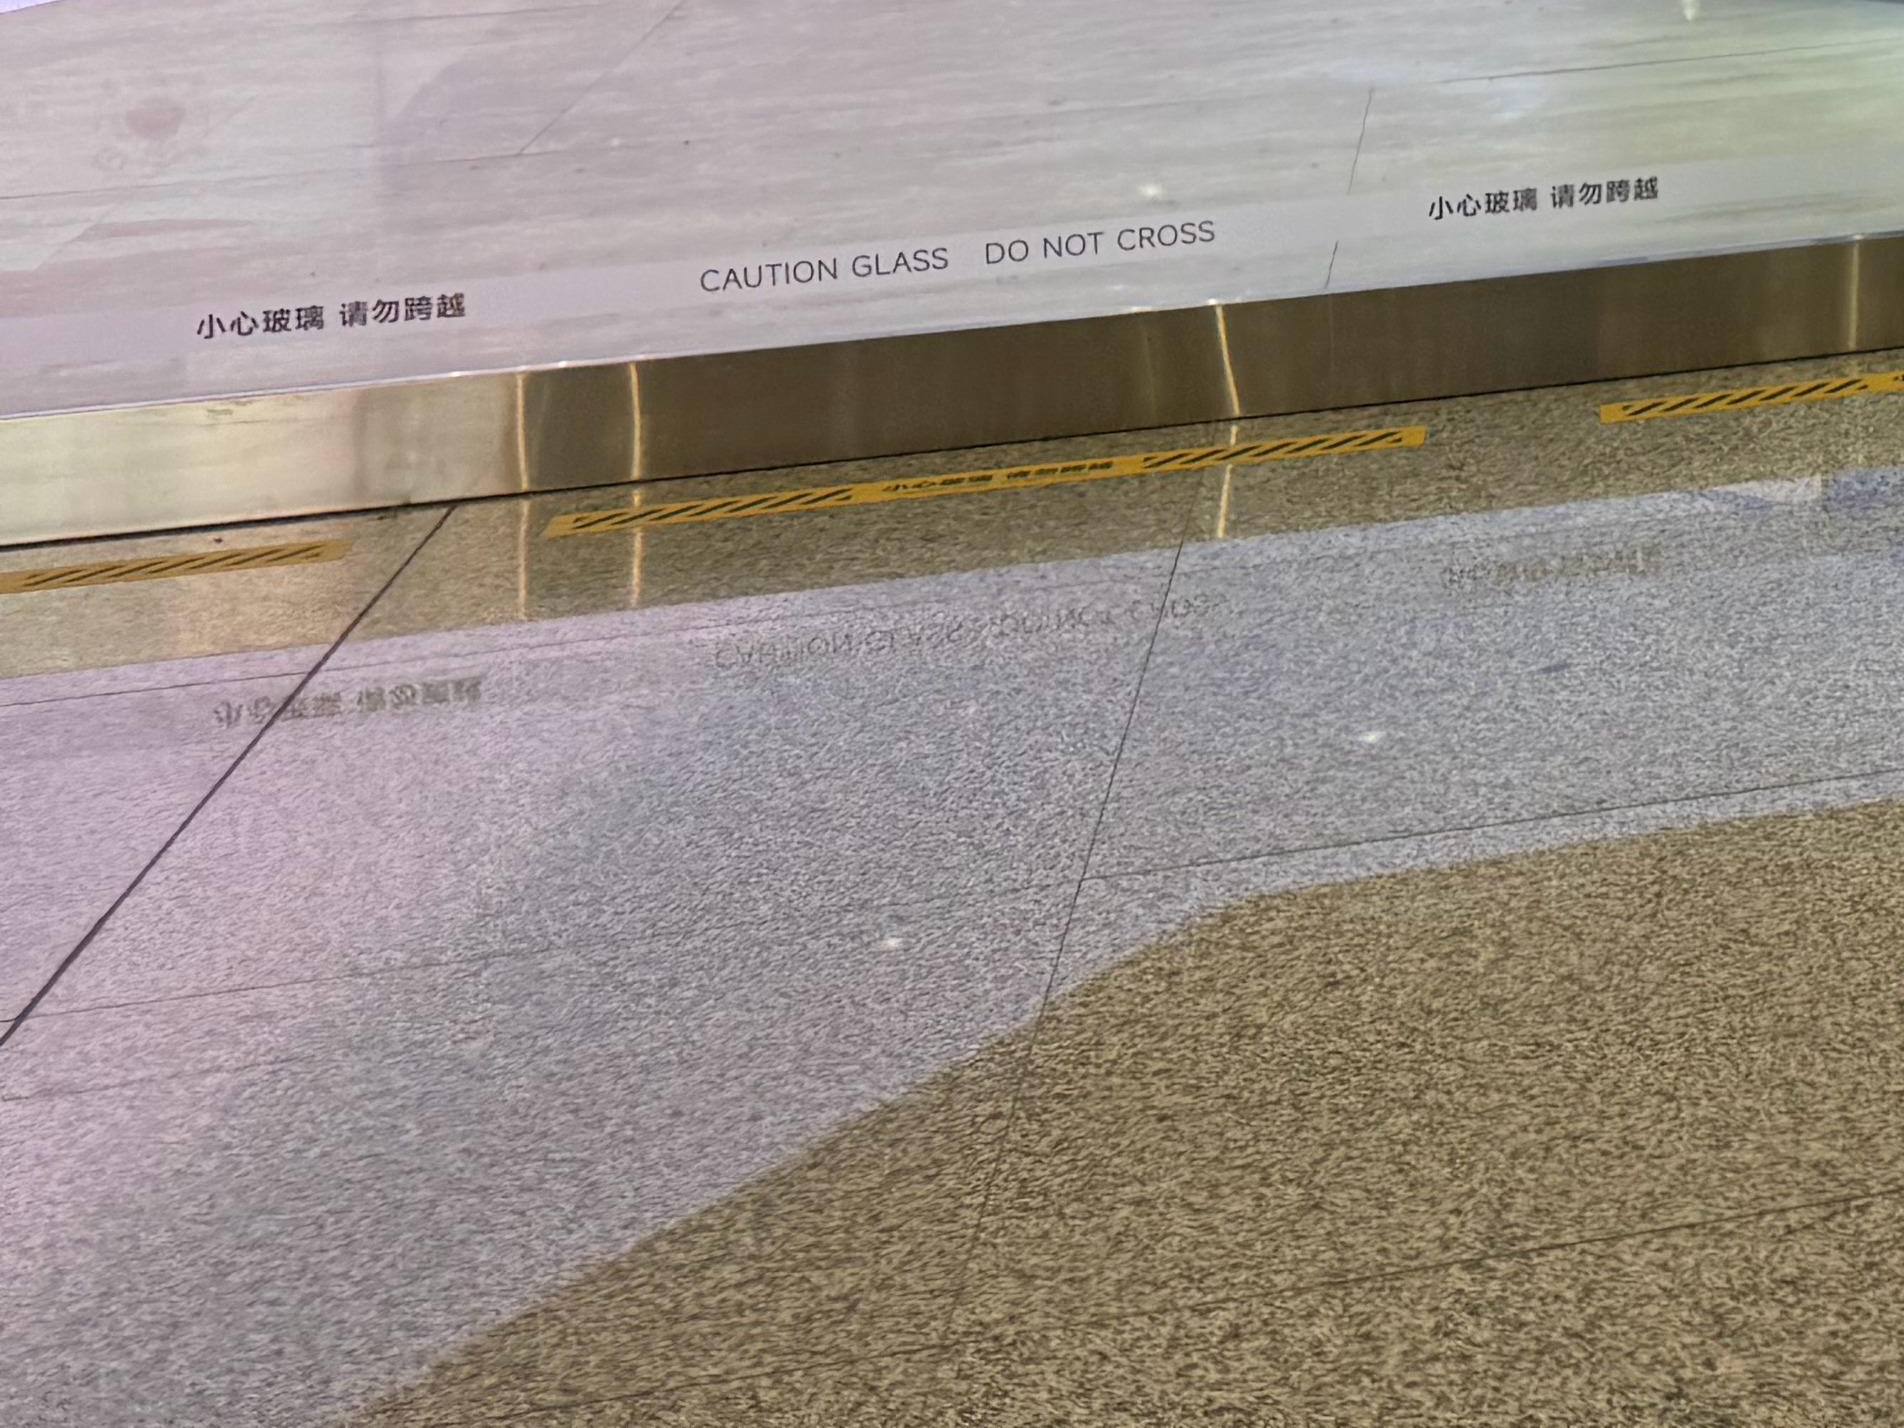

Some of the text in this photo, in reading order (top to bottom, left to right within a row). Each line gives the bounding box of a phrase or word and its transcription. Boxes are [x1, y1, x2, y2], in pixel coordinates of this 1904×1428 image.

[1429, 176, 1658, 220] 小心玻璃 请勿跨越
[700, 221, 1215, 293] CAUTION GLASS DO NOT CROSS
[197, 293, 466, 339] 小心玻璃 请勿跨越
